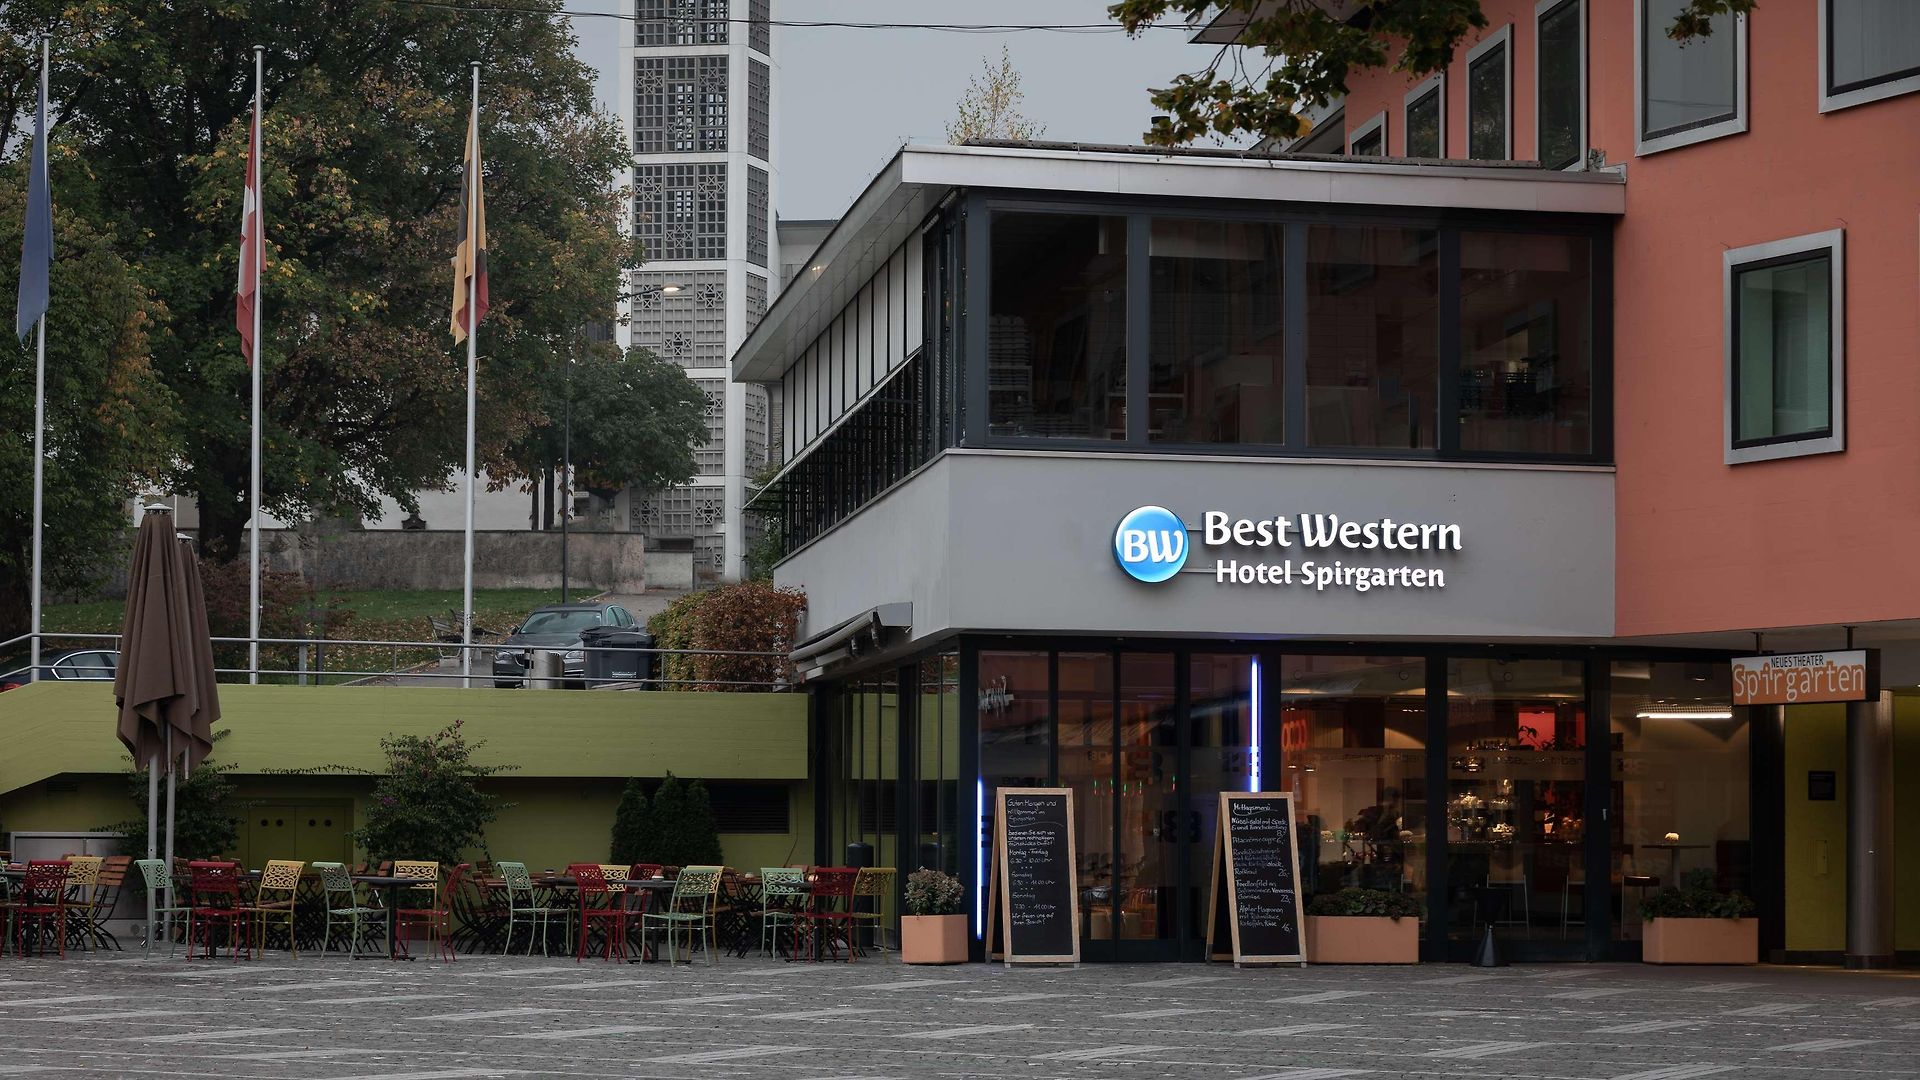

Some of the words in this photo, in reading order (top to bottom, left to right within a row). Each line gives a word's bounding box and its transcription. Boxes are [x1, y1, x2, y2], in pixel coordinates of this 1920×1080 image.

[1123, 529, 1184, 564] BW
[1203, 510, 1292, 547] Best
[1299, 512, 1462, 551] Western
[1216, 560, 1292, 585] Hotel
[1300, 560, 1446, 592] Spirgarten
[1771, 656, 1792, 668] NEUES
[1794, 654, 1824, 667] THEATER
[1734, 664, 1864, 704] Spirgarten
